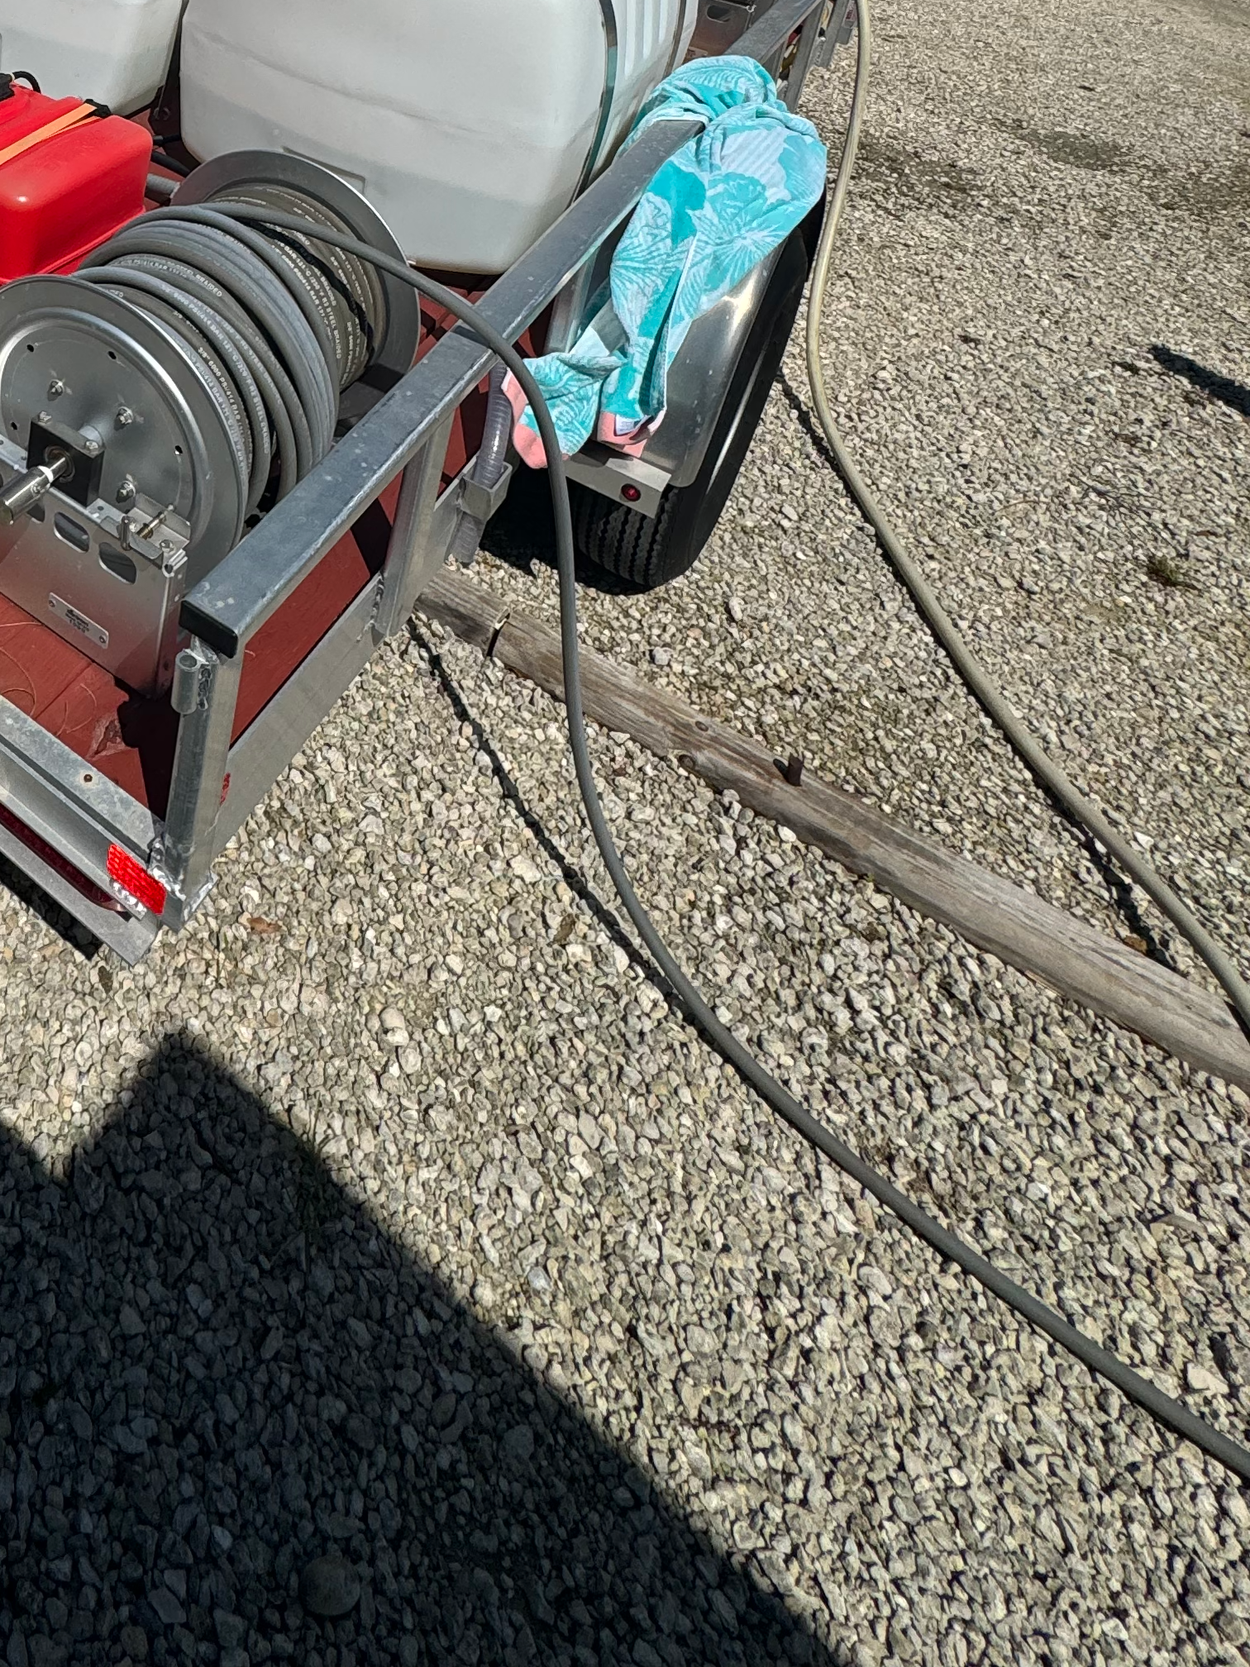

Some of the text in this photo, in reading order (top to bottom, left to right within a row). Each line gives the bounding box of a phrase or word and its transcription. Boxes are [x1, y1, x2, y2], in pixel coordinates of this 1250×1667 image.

[195, 273, 222, 297] BRAIDED
[325, 307, 337, 328] STEEL
[207, 360, 221, 376] 6000
[231, 403, 240, 419] BAR
